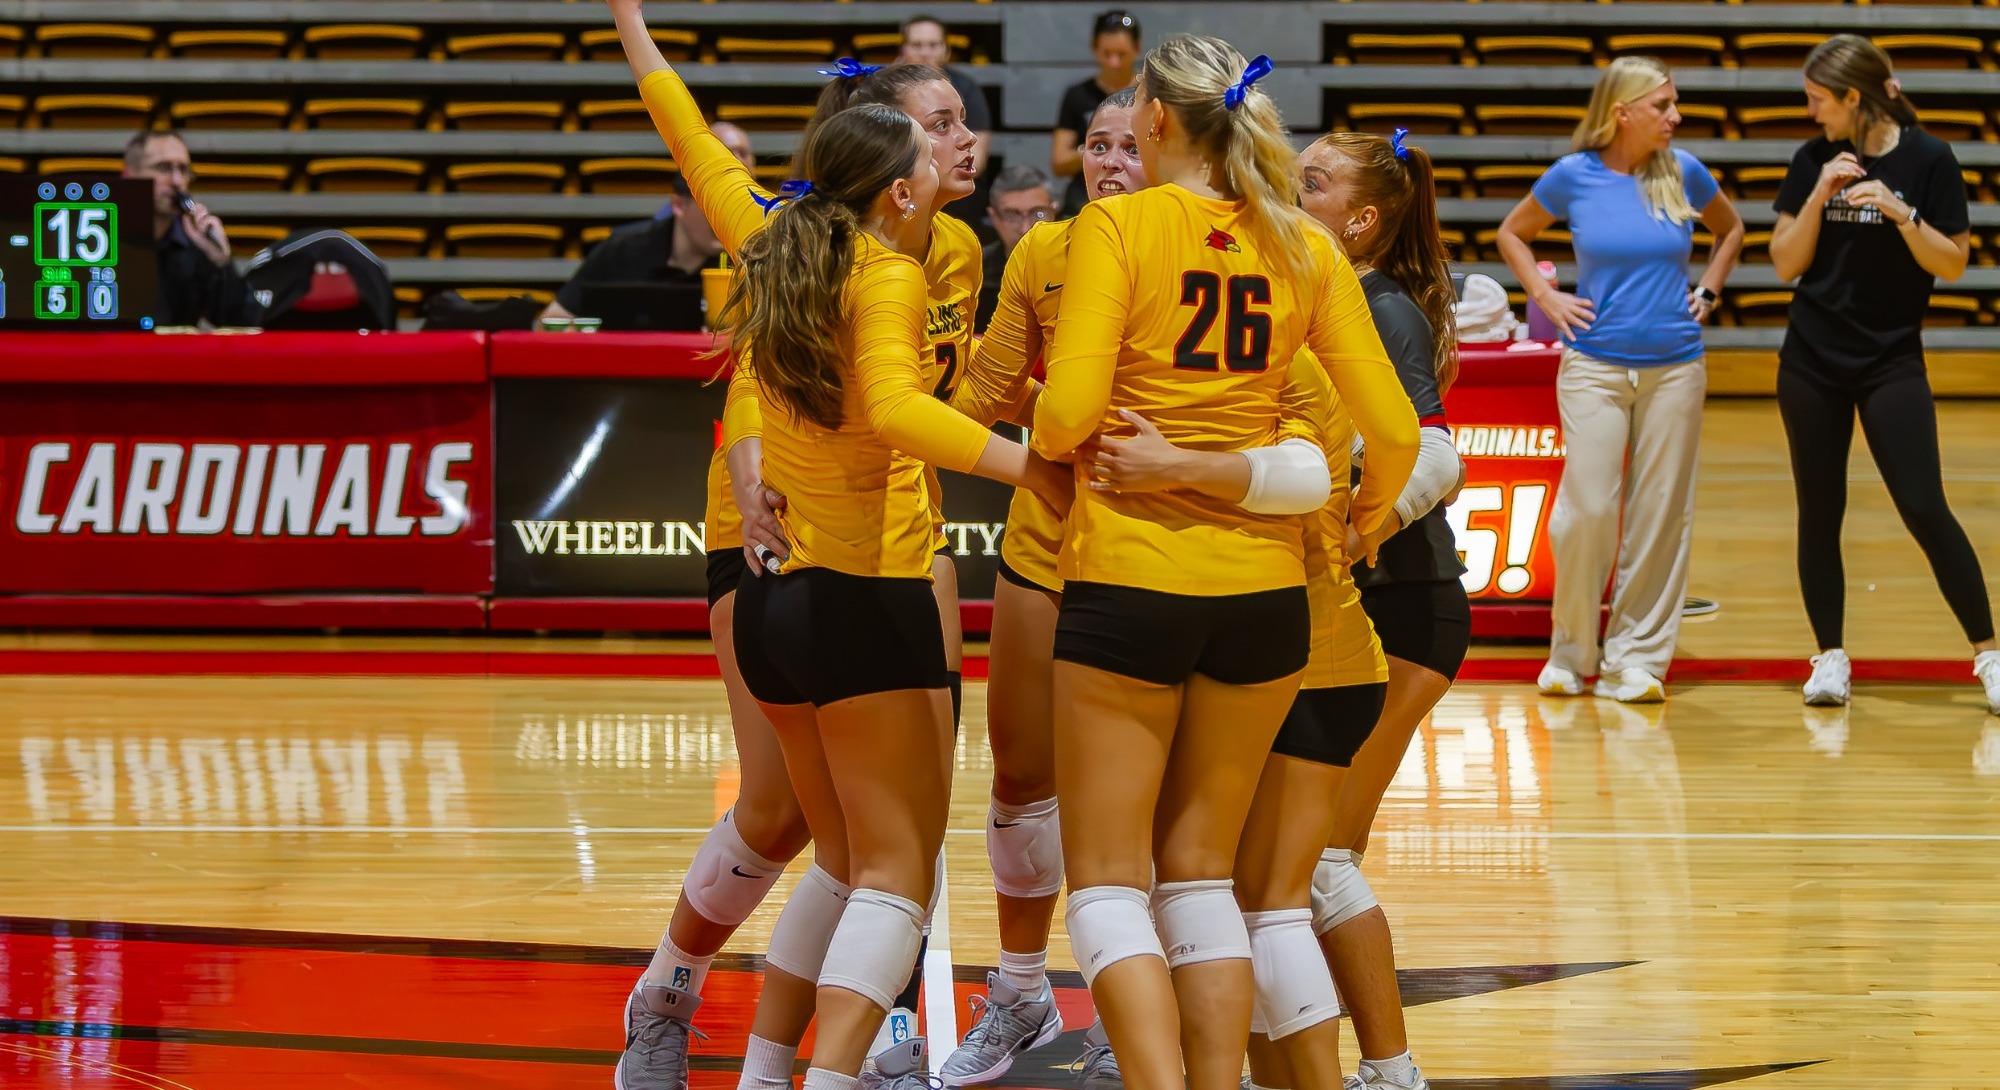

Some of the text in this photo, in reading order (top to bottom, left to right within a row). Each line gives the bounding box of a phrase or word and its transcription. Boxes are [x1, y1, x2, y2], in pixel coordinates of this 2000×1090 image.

[48, 207, 109, 263] 15
[47, 285, 112, 314] 5 0
[1173, 269, 1273, 374] 26
[16, 442, 473, 536] CARDINALS
[941, 521, 1005, 556] TY
